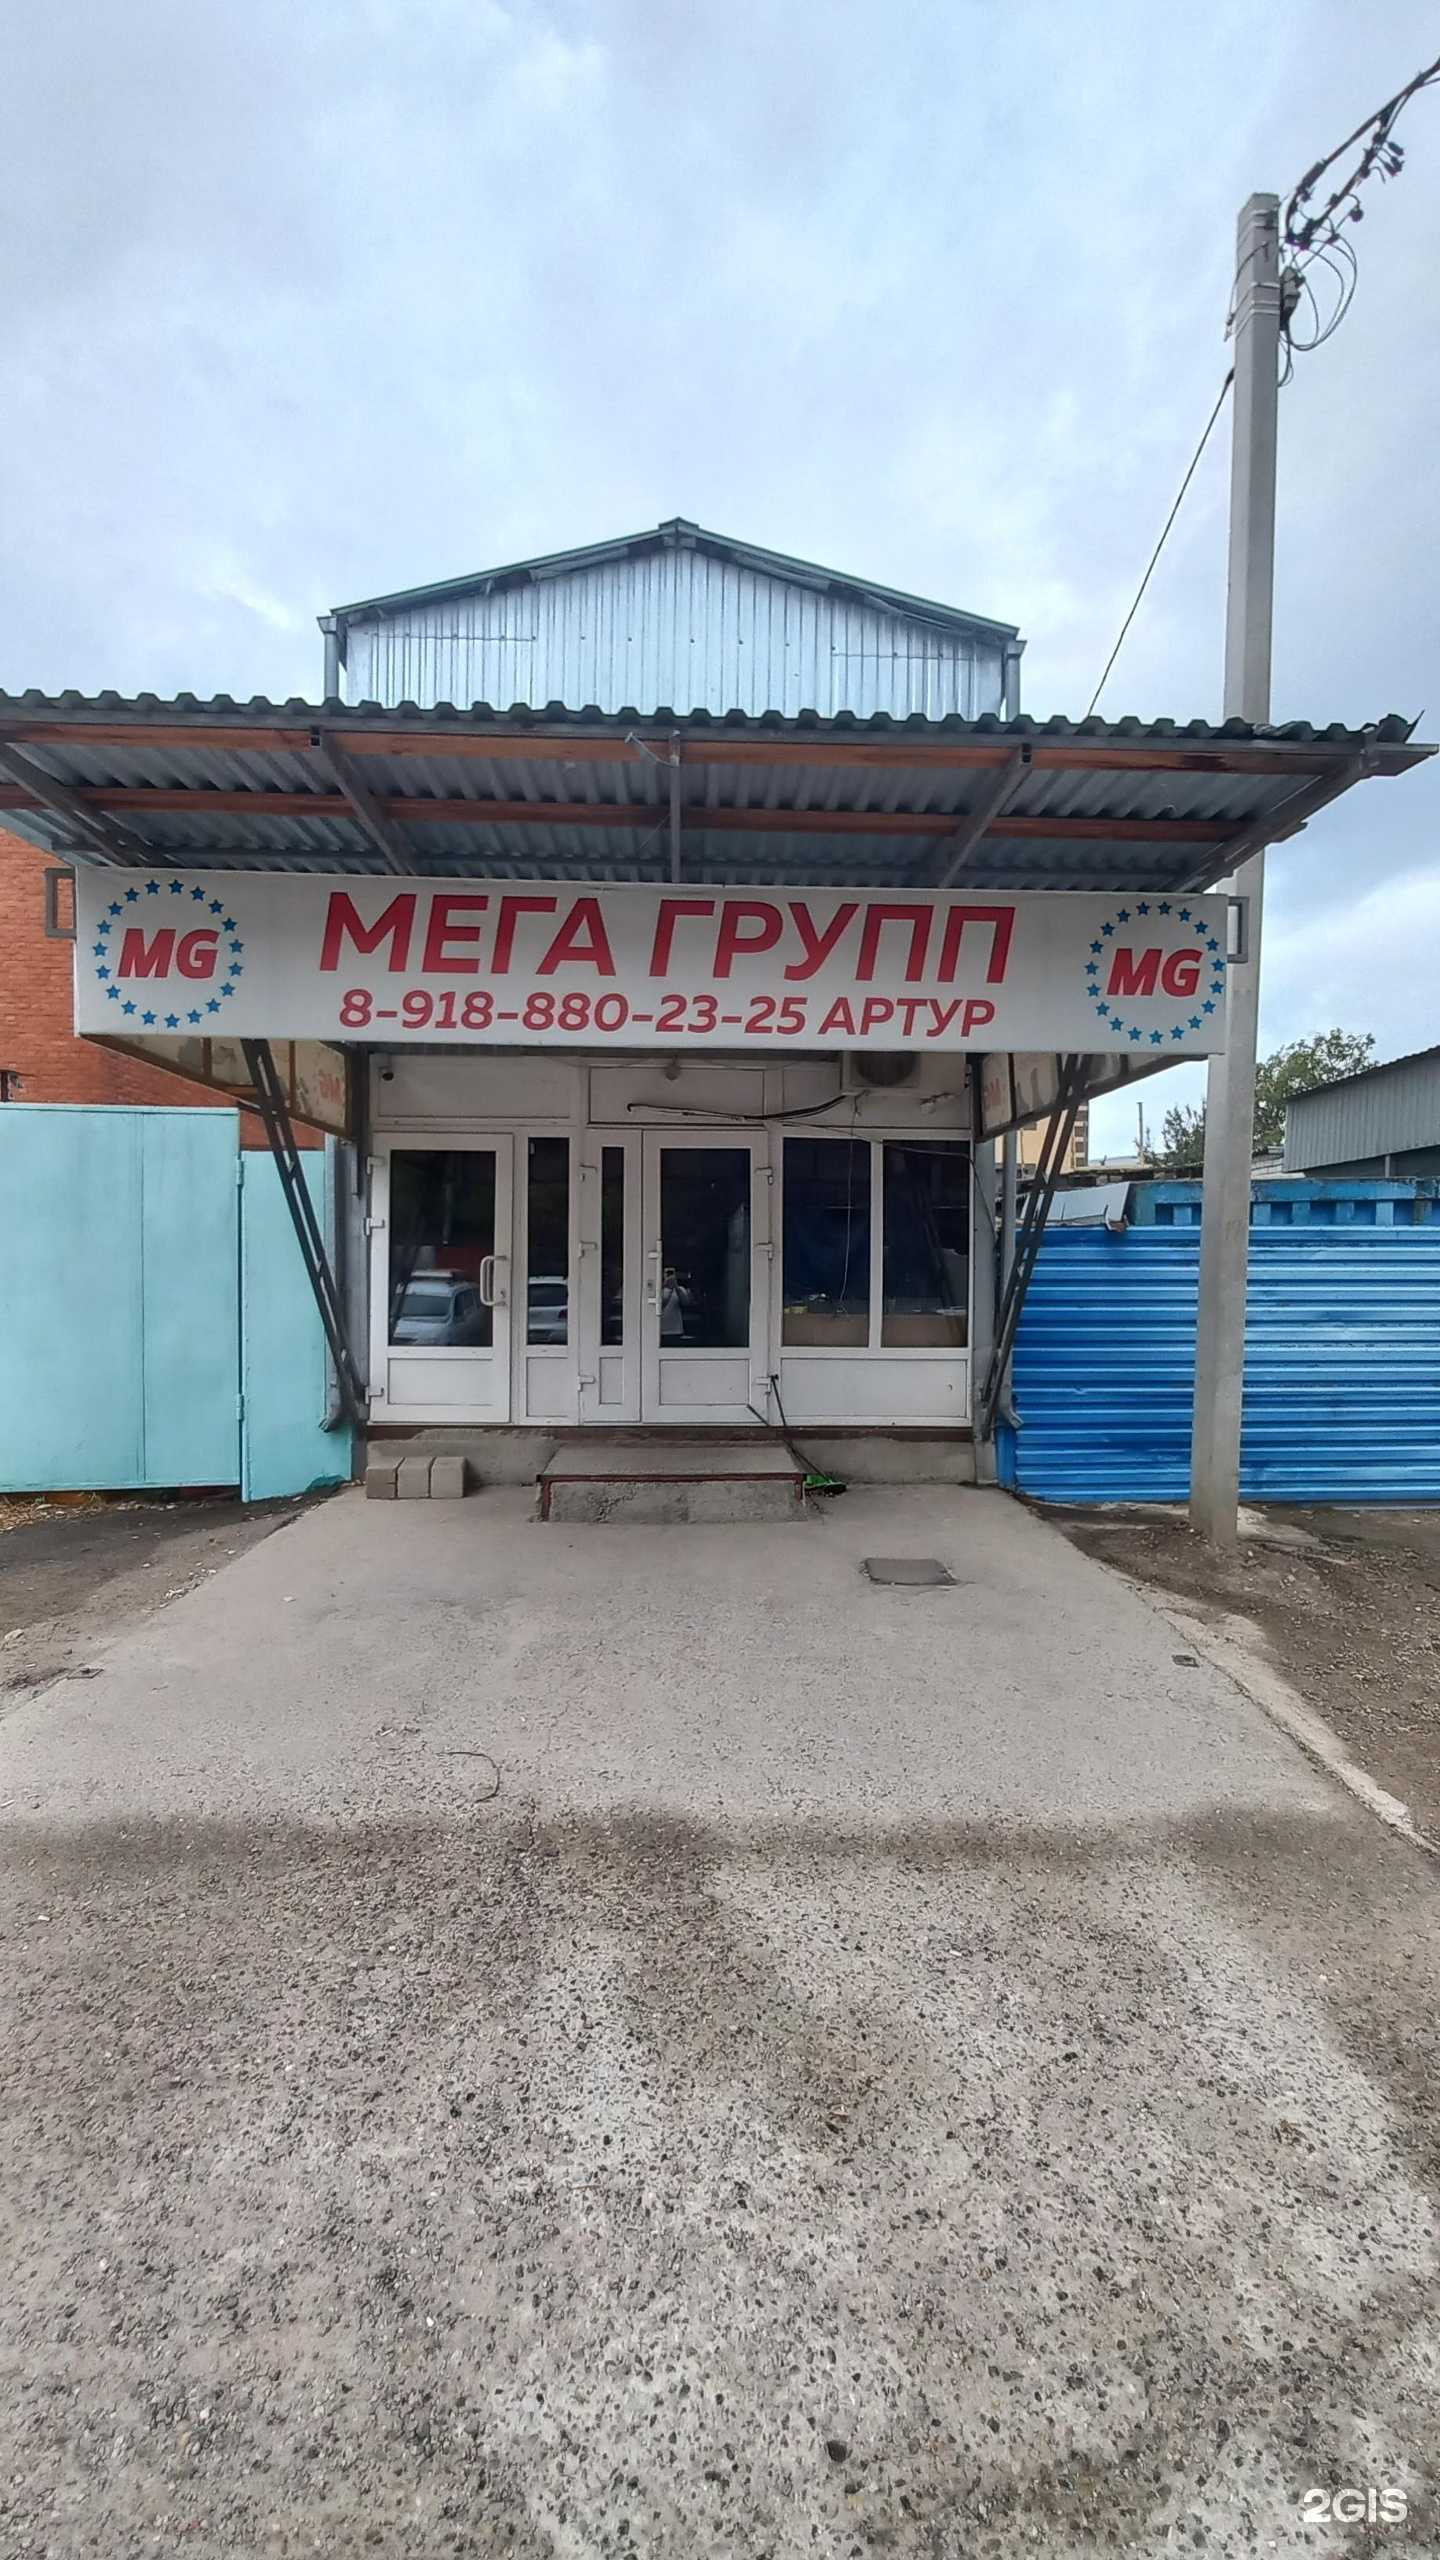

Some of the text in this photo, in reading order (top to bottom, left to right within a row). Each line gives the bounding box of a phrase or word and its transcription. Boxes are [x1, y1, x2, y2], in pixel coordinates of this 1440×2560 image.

[118, 928, 219, 979] MG
[319, 892, 1015, 983] МЕГА ГРУПП
[1106, 948, 1202, 997] MG
[339, 988, 996, 1038] 8-918-880-23-25 АРТУР
